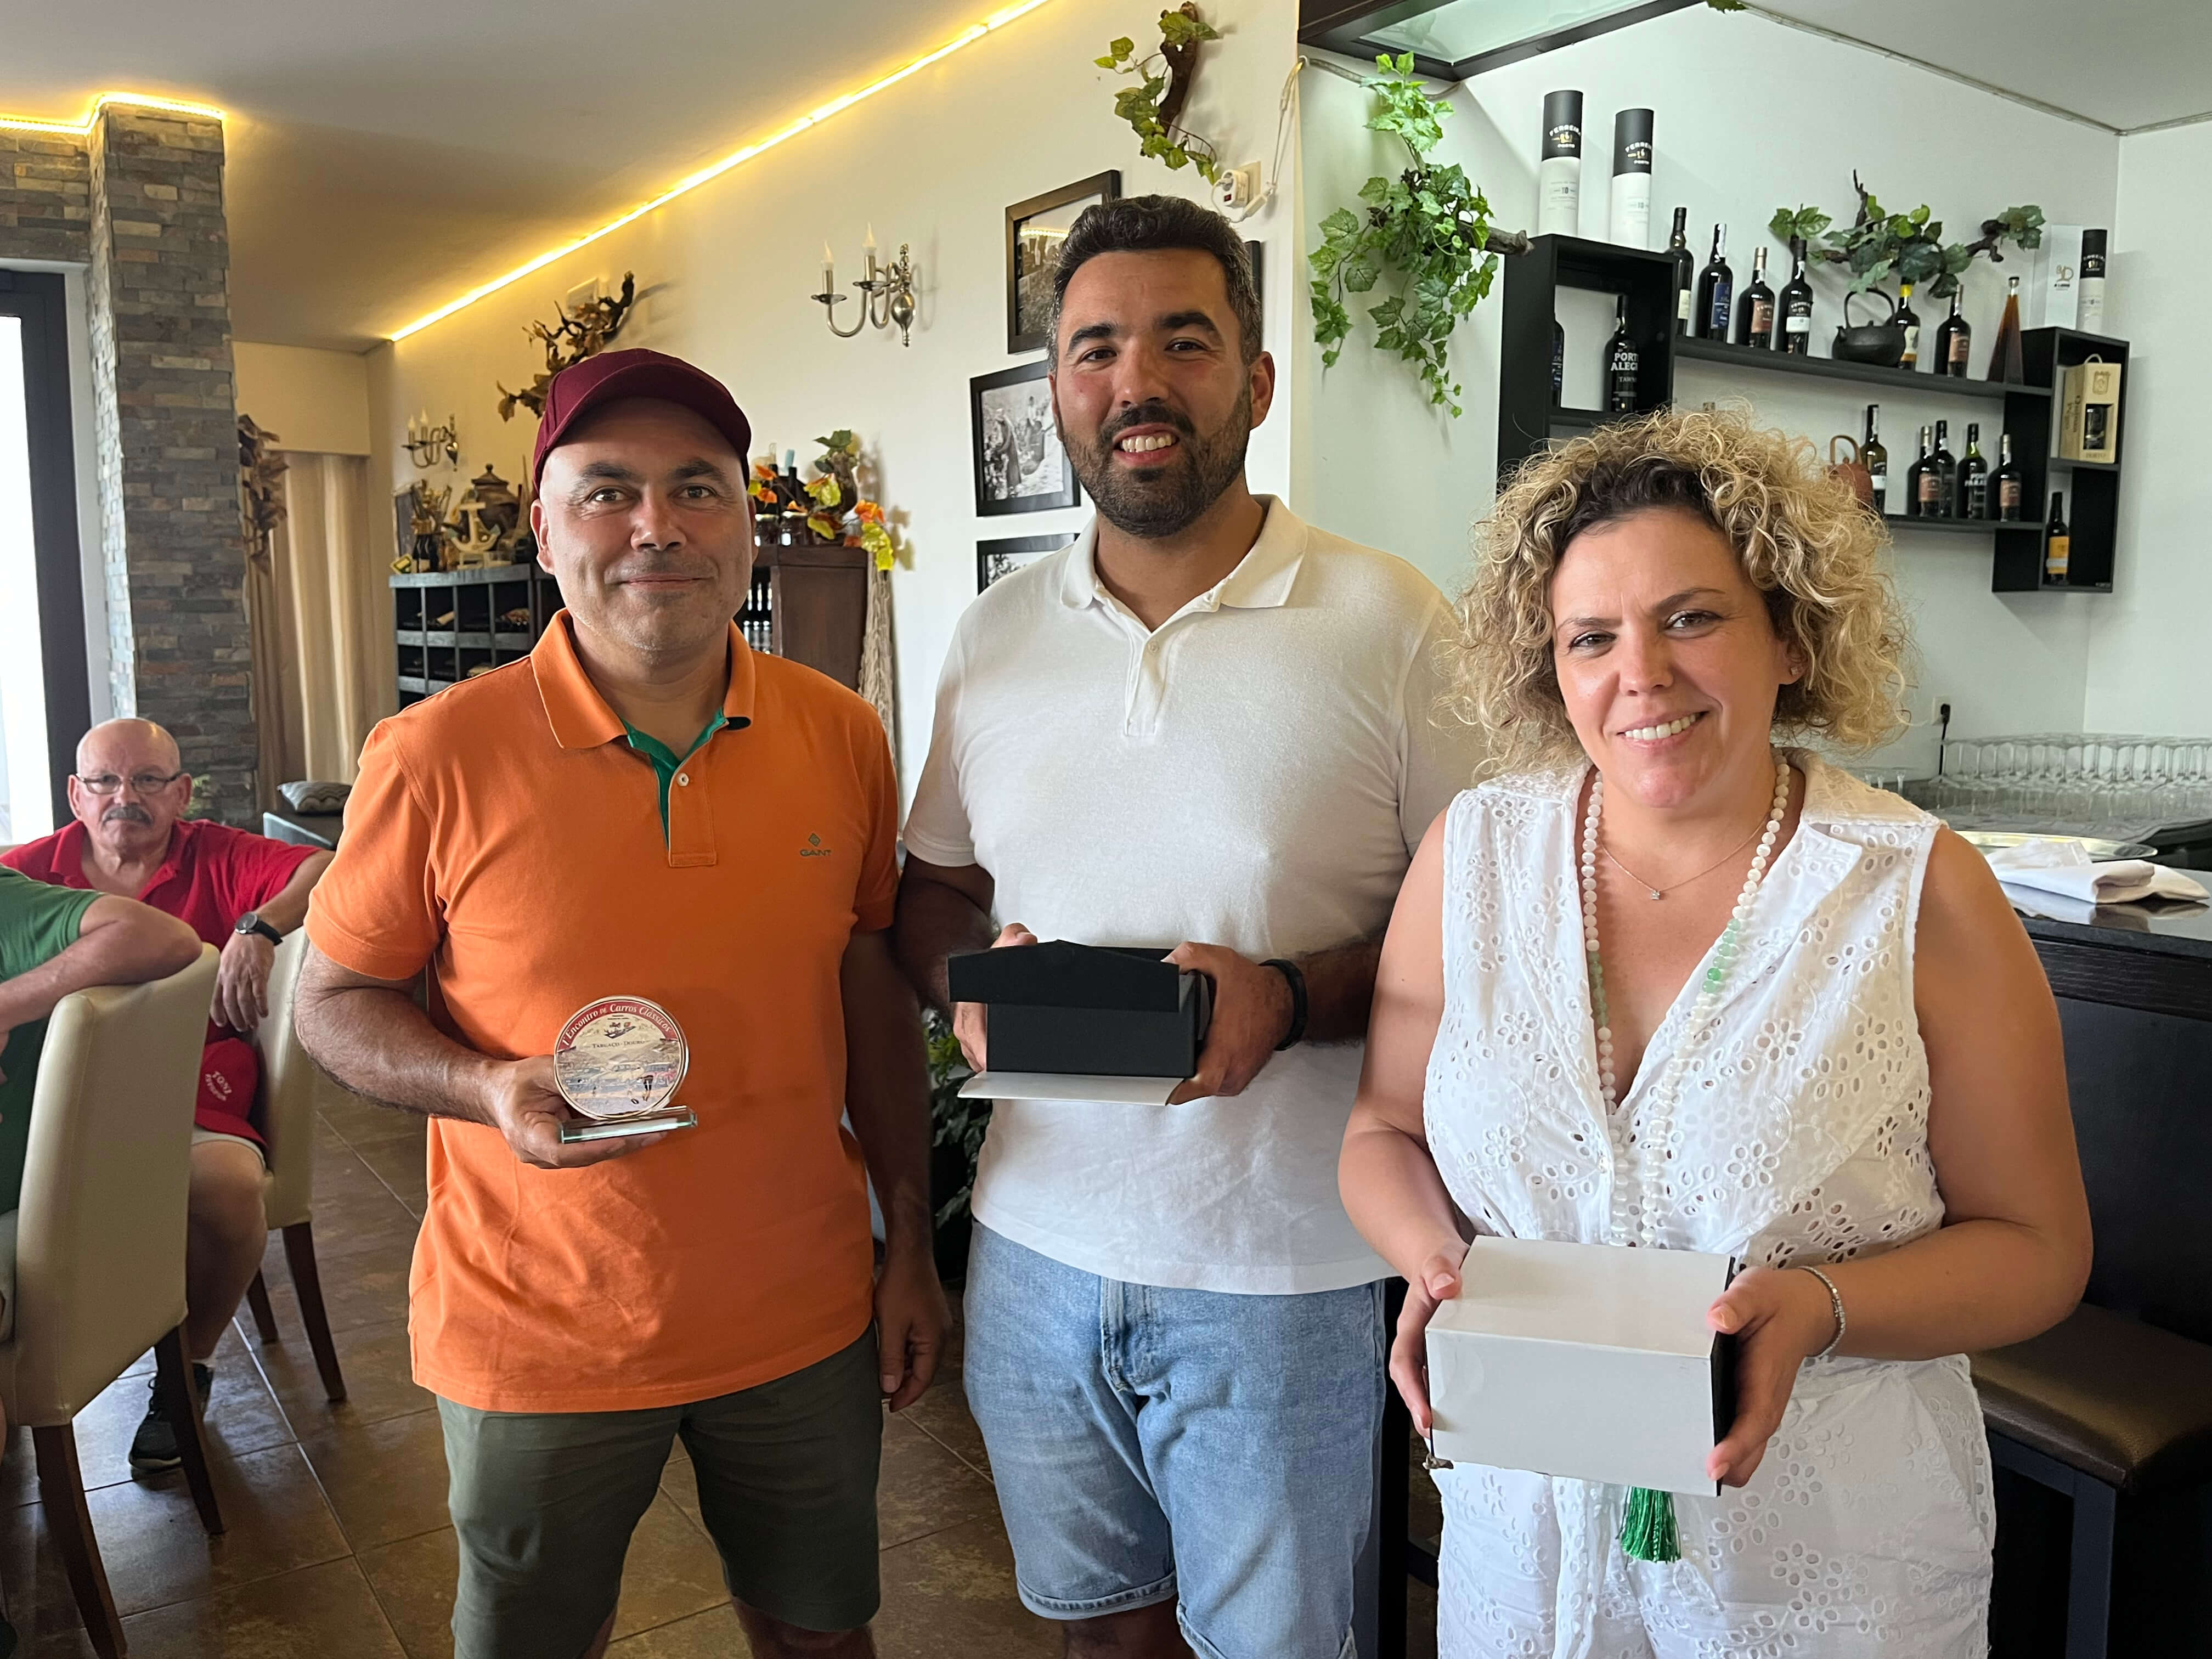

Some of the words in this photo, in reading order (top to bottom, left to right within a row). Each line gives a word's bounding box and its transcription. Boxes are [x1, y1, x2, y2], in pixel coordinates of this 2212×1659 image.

[1615, 352, 1639, 362] PORT
[566, 1010, 599, 1039] Encontro
[610, 1003, 636, 1013] Carros
